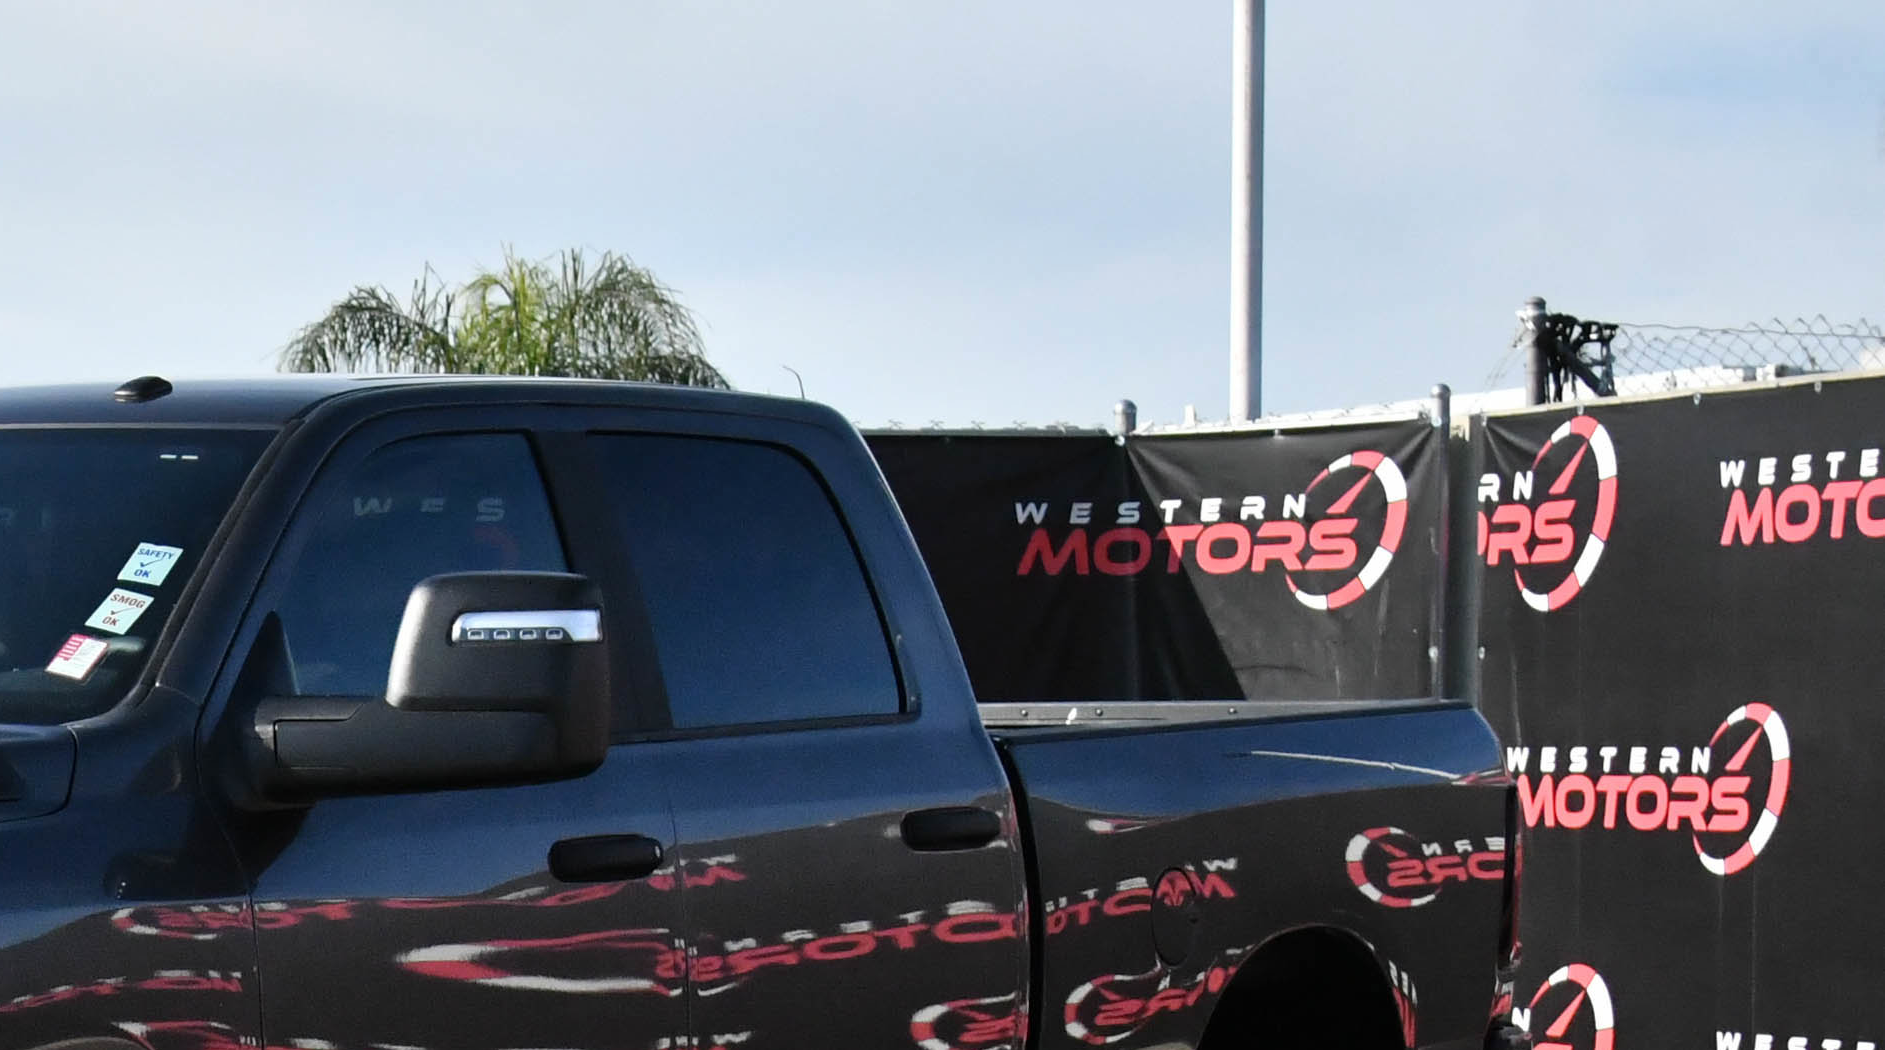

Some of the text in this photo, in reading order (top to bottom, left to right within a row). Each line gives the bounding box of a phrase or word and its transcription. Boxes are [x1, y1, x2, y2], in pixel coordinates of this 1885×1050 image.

[1719, 448, 1880, 488] WESTE
[1015, 493, 1307, 525] WESTERN
[1720, 477, 1885, 547] MOTO
[137, 548, 176, 560] SAFETY
[1017, 517, 1360, 577] MOTORS
[133, 569, 152, 579] OK
[110, 594, 147, 609] SMOG
[101, 616, 119, 627] OK
[1505, 745, 1712, 775] WESTERN
[1517, 773, 1753, 833] MOTORS
